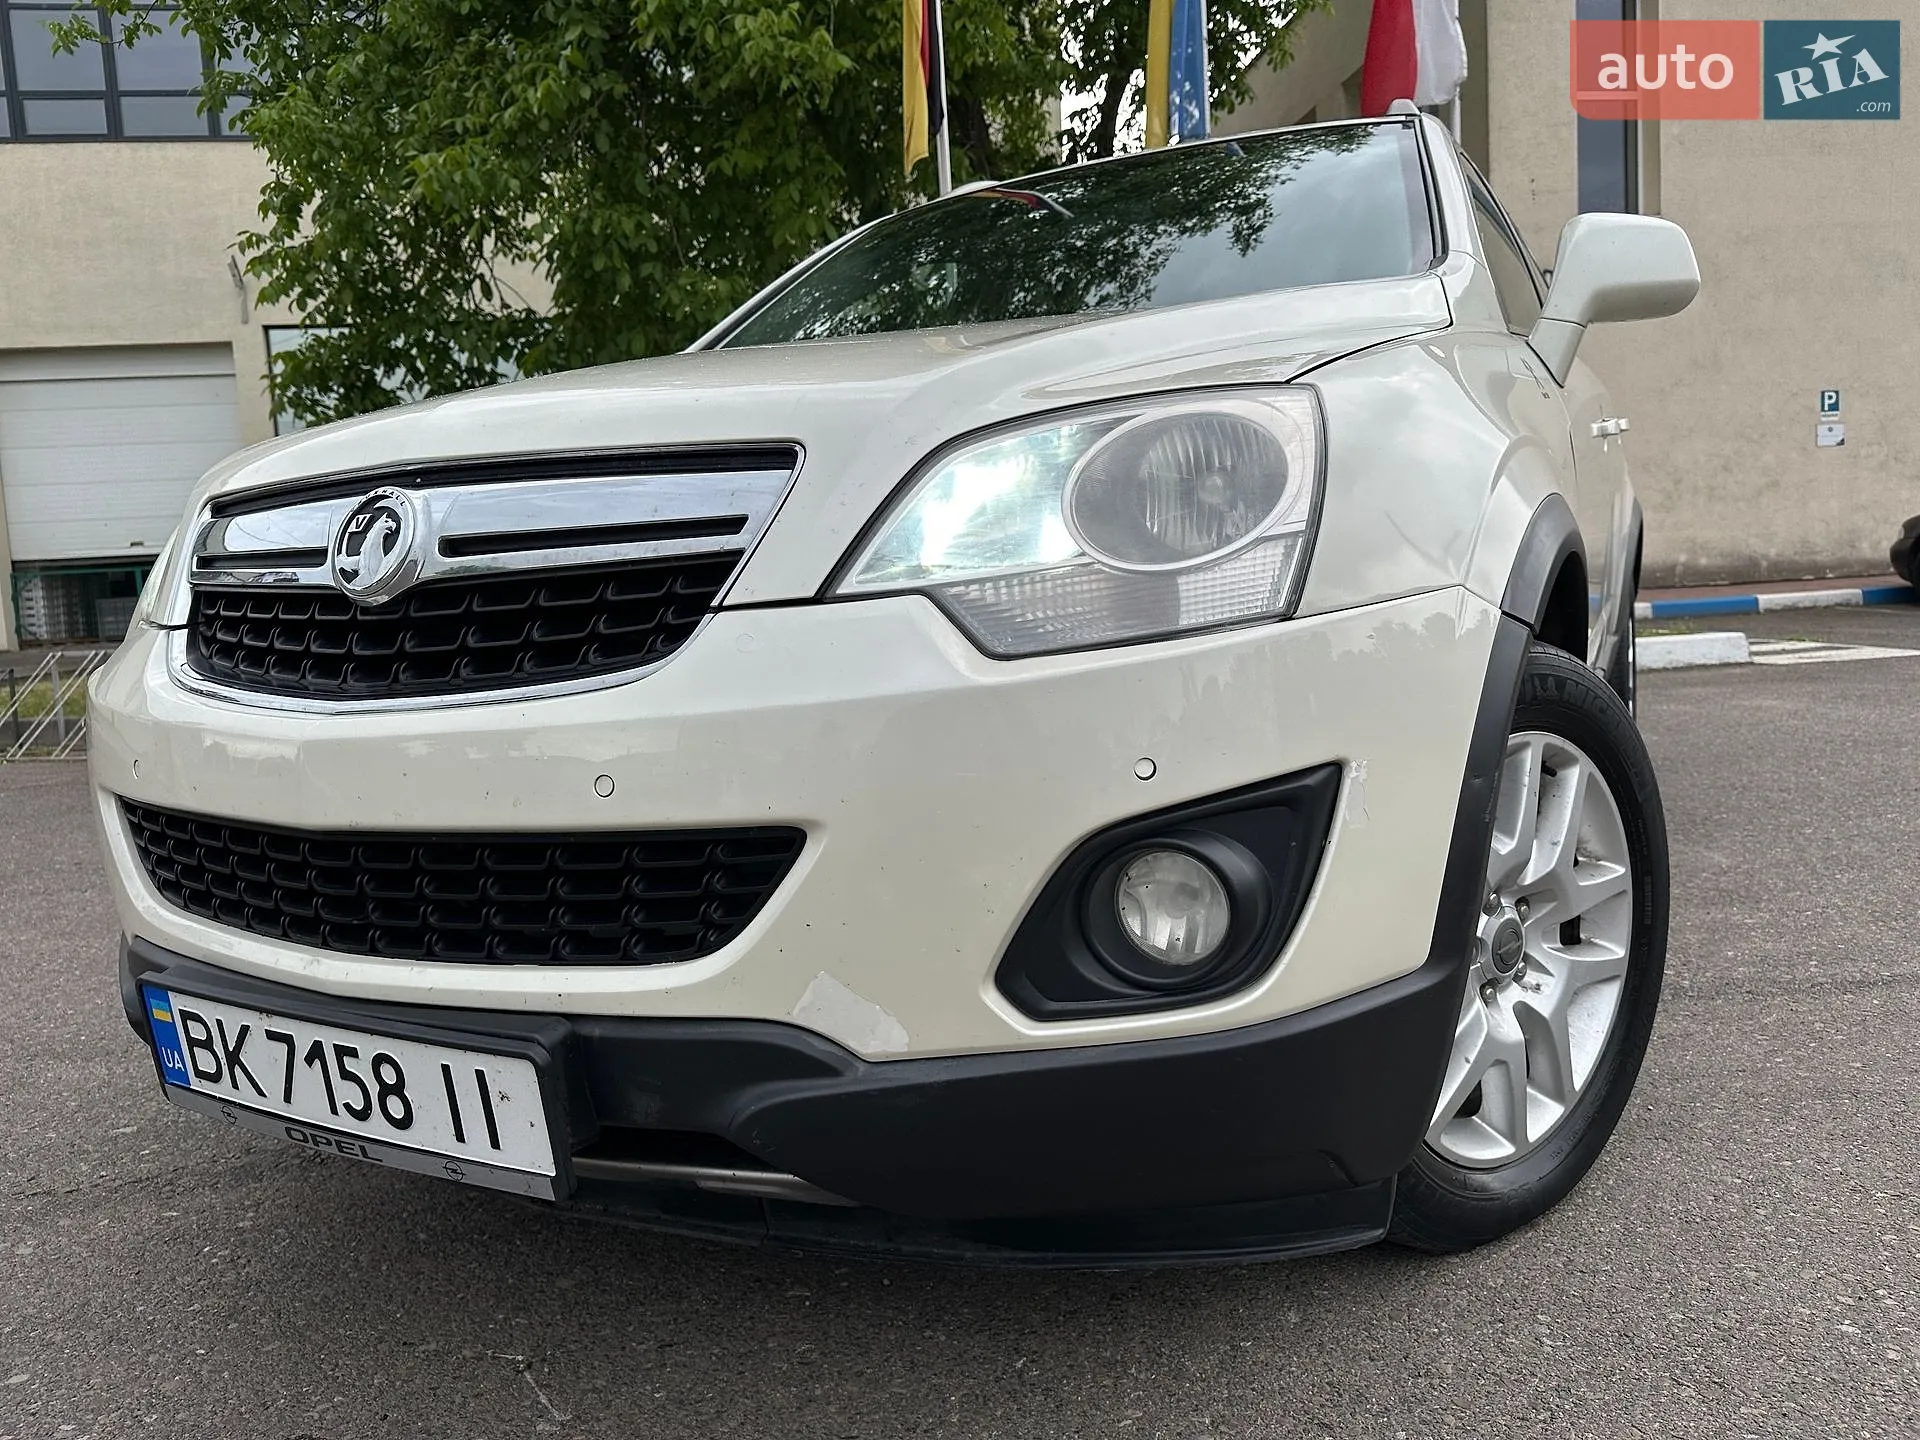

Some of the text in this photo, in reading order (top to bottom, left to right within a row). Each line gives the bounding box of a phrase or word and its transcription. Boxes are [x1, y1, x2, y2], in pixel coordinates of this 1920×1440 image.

[1824, 391, 1837, 411] P
[161, 1046, 185, 1073] UA
[178, 1008, 501, 1150] BK 7158 II
[285, 1126, 383, 1163] OPEL
